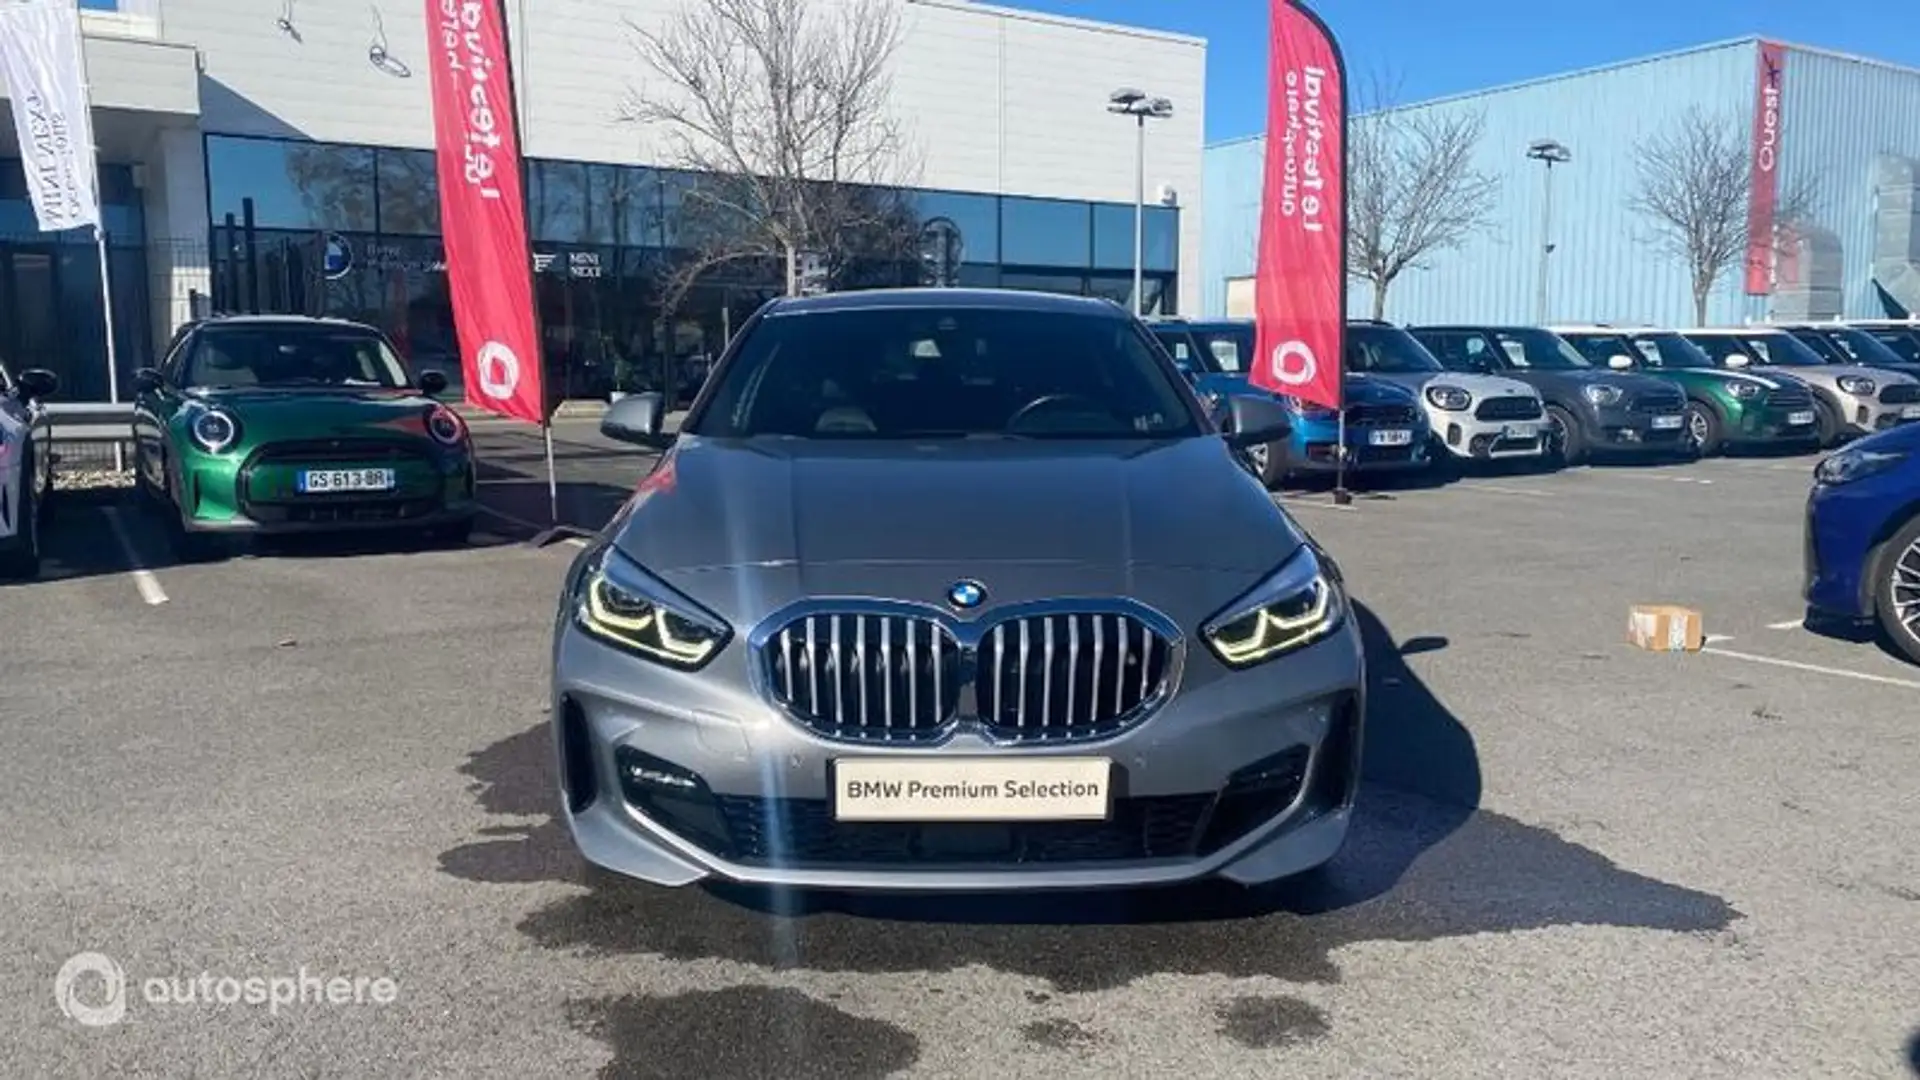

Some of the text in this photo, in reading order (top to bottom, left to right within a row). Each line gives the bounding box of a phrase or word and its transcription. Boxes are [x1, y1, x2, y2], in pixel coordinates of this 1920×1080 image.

[1758, 83, 1779, 172] Ouest
[847, 779, 1099, 798] BMW Premium Selection
